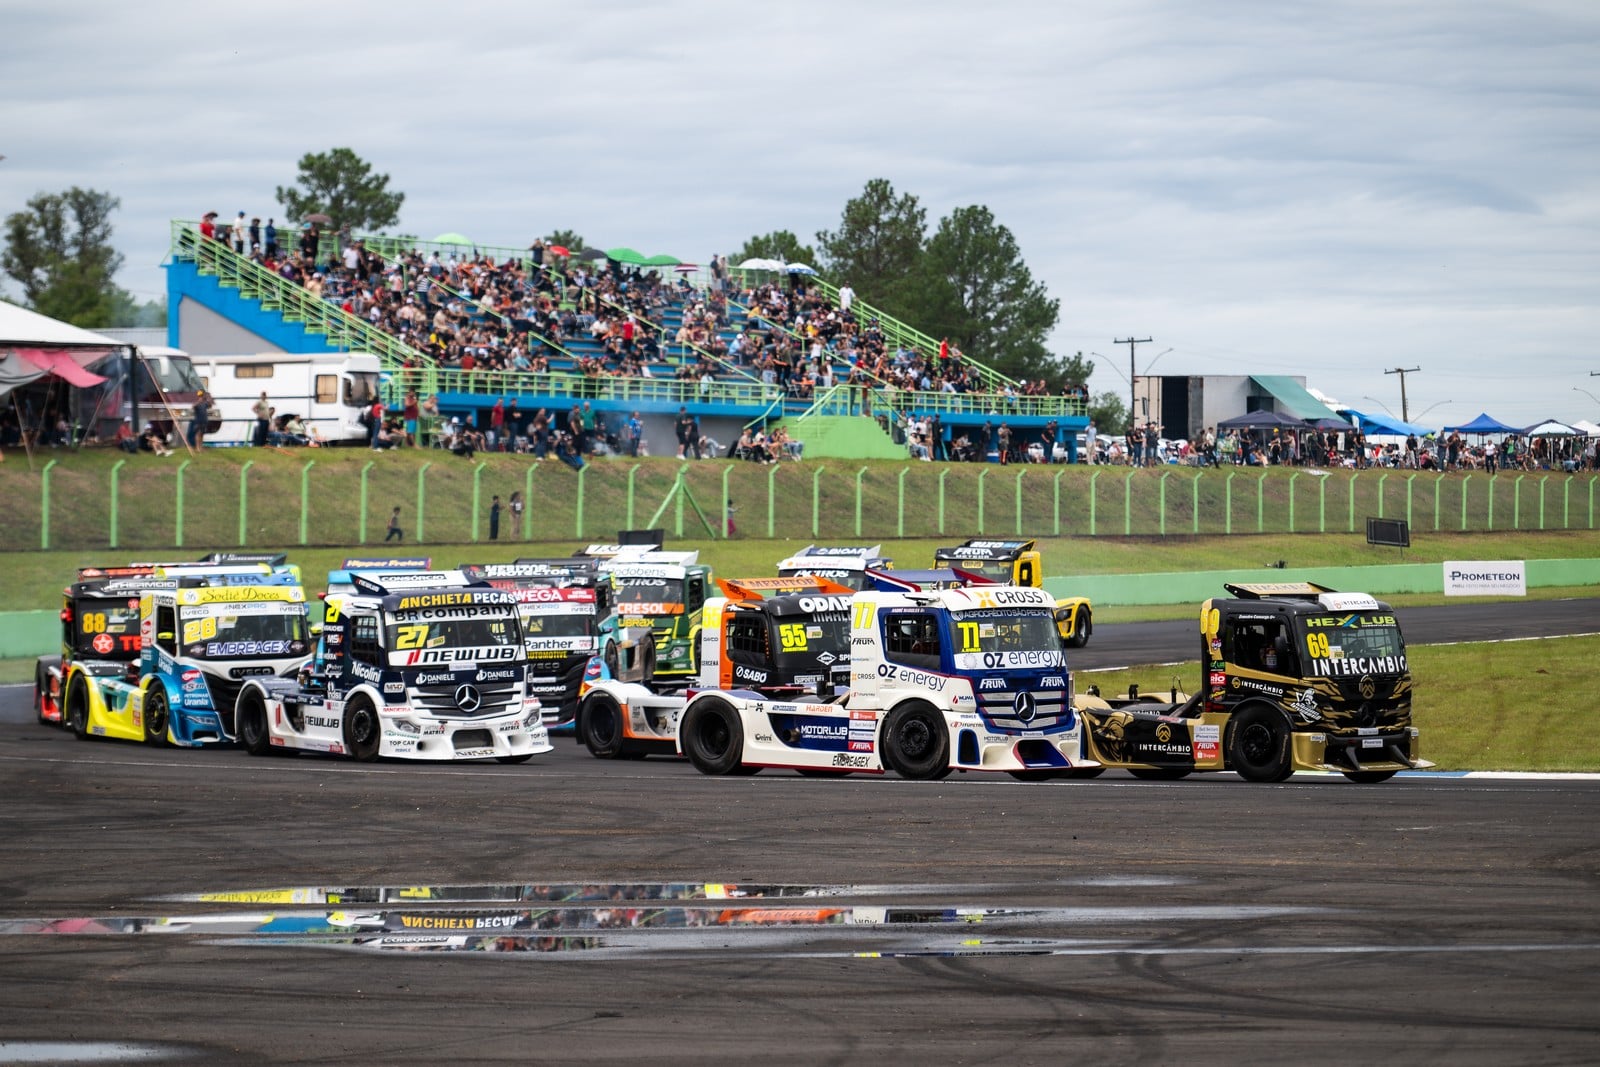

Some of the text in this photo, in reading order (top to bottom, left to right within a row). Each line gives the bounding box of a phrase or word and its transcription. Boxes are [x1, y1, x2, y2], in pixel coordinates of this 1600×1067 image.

[1449, 571, 1520, 581] PROMETEON
[241, 587, 280, 601] Doces
[398, 592, 516, 610] ANCHIETA PEÇAS
[511, 589, 563, 602] WEGA
[995, 591, 1043, 604] CROSS
[616, 603, 667, 614] CRESOL
[799, 596, 852, 613] ODAP
[182, 608, 210, 617] IVECO
[394, 604, 513, 622] BR company
[853, 602, 877, 630] 77
[83, 612, 107, 634] 88
[183, 617, 217, 646] 28
[396, 625, 430, 650] 27
[779, 623, 807, 648] 55
[205, 640, 293, 657] EMBREAGEX
[524, 639, 574, 650] Panther
[1306, 632, 1331, 658] 69
[422, 647, 515, 664] NEWLUB
[983, 650, 1060, 669] OZ energy
[351, 660, 383, 683] Nicolini
[428, 673, 456, 682] DANIELE
[487, 670, 515, 679] DANIELE
[877, 663, 947, 692] OZ energy
[979, 678, 1007, 689] FRUM
[1040, 676, 1066, 687] FRUM
[806, 705, 833, 713] HARDEN
[800, 725, 848, 736] MOTORLUB
[1139, 743, 1191, 753] INTERCÂMBIO
